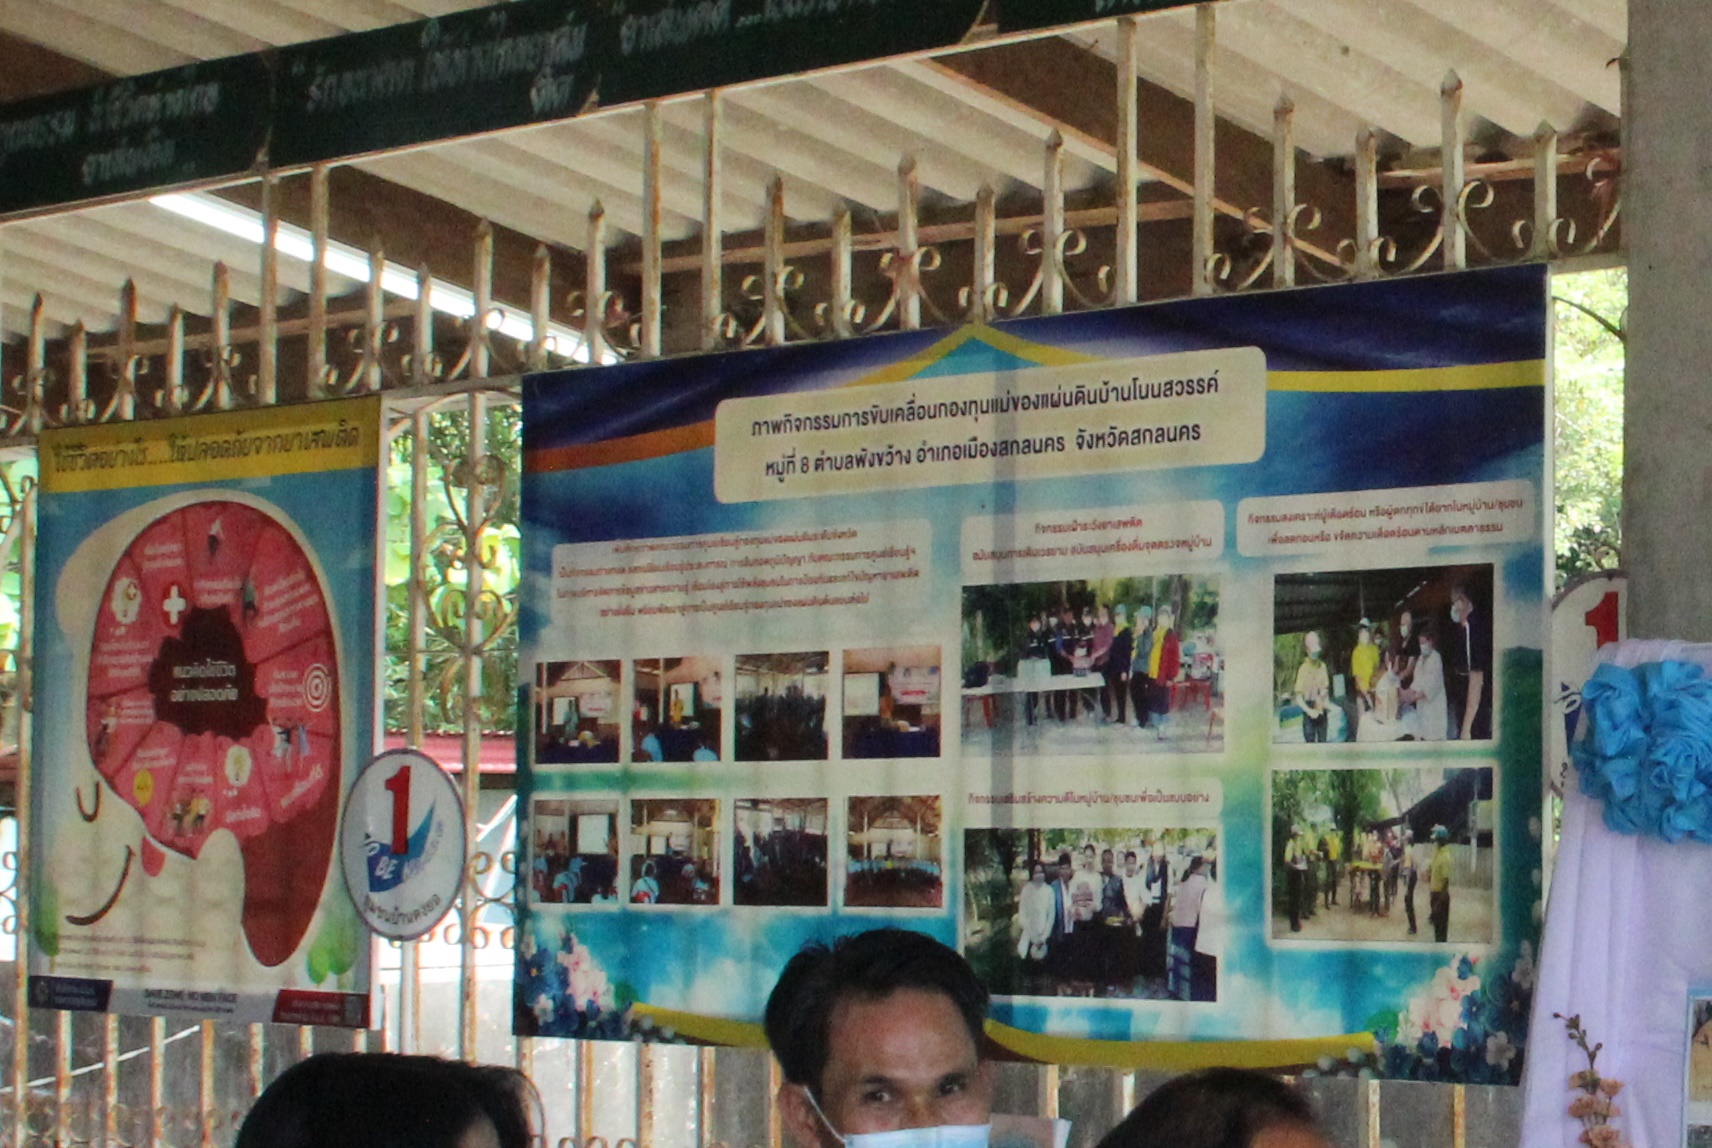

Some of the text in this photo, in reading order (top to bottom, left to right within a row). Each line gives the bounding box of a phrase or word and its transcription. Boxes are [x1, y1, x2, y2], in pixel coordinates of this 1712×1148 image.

[750, 370, 1220, 437] ภาพกิจกรรมการขับเคลื่อนกองทุนแม่ของแผ่นดินบ้านโนนสวรรค์
[765, 451, 797, 484] หมู่ที่
[800, 454, 810, 474] 8
[916, 434, 1066, 464] อำเภอเมืองสกลนคร
[1075, 422, 1202, 450] จังหวัดสกลนคร
[384, 764, 412, 855] 1
